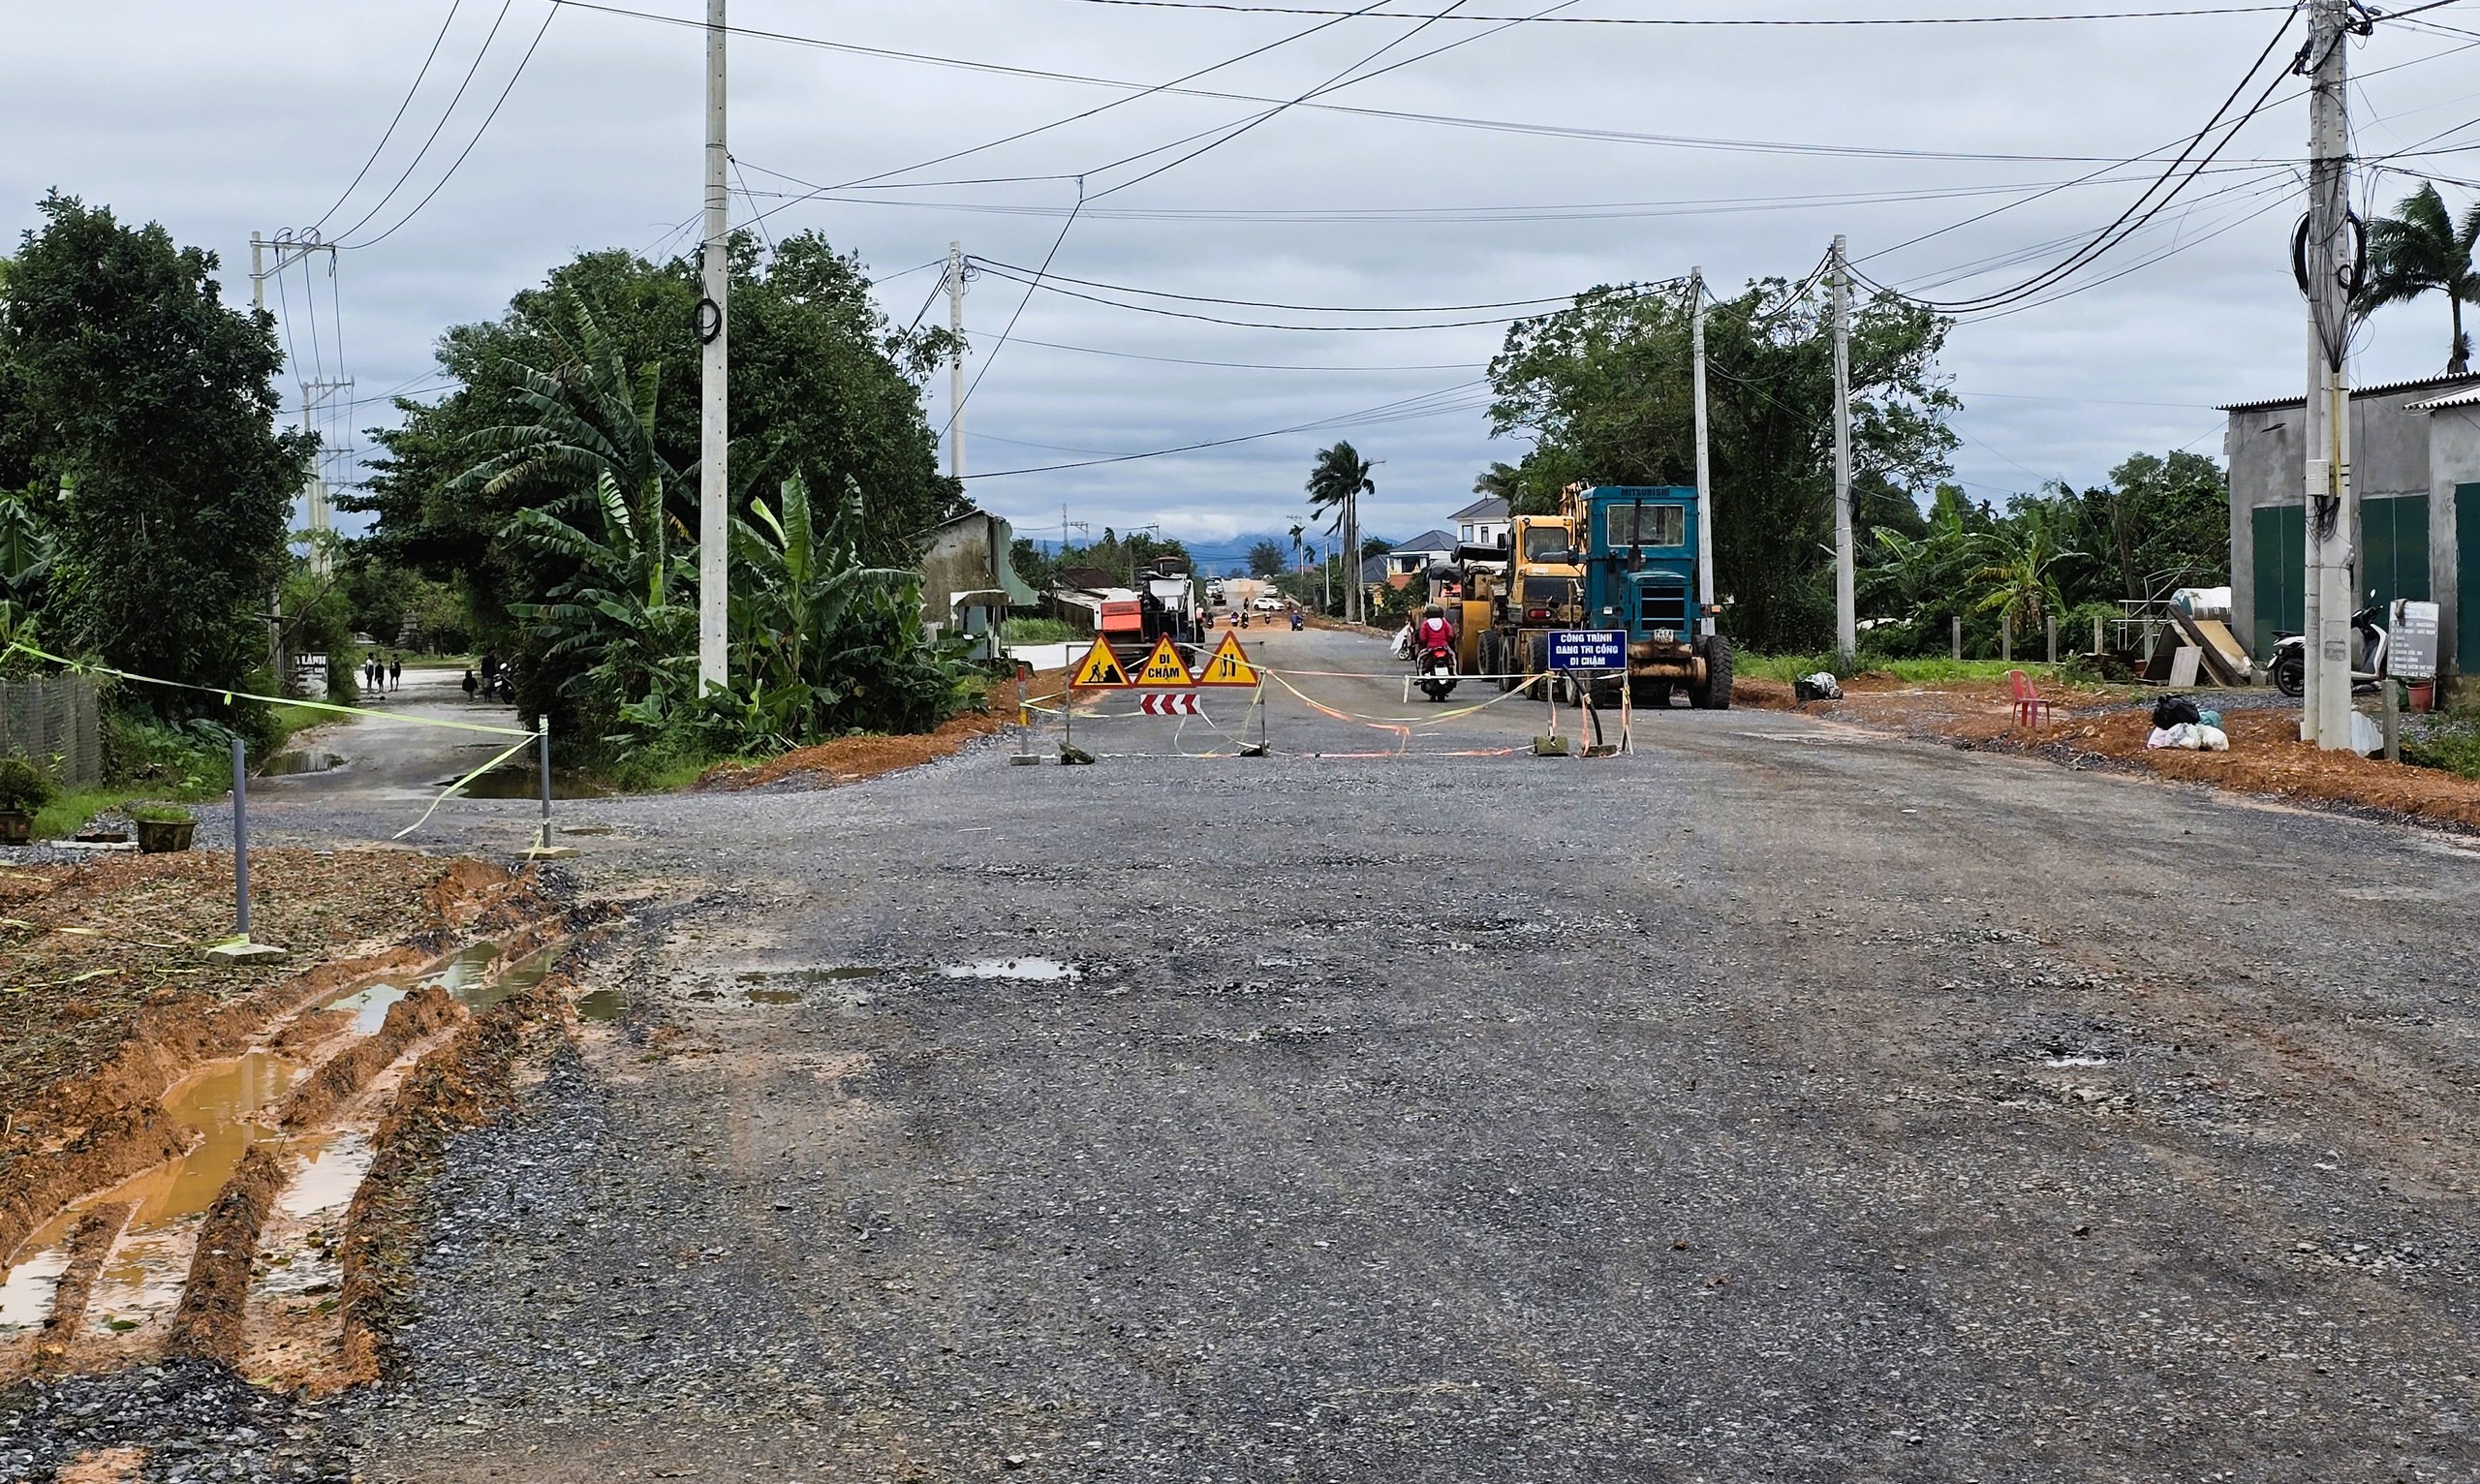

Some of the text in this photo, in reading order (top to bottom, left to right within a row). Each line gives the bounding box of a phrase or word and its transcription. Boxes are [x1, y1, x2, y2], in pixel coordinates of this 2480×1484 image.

[1621, 488, 1670, 497] MITSUBISHI
[1561, 632, 1613, 642] CÔNG TRÌNH
[1580, 645, 1594, 654] THI
